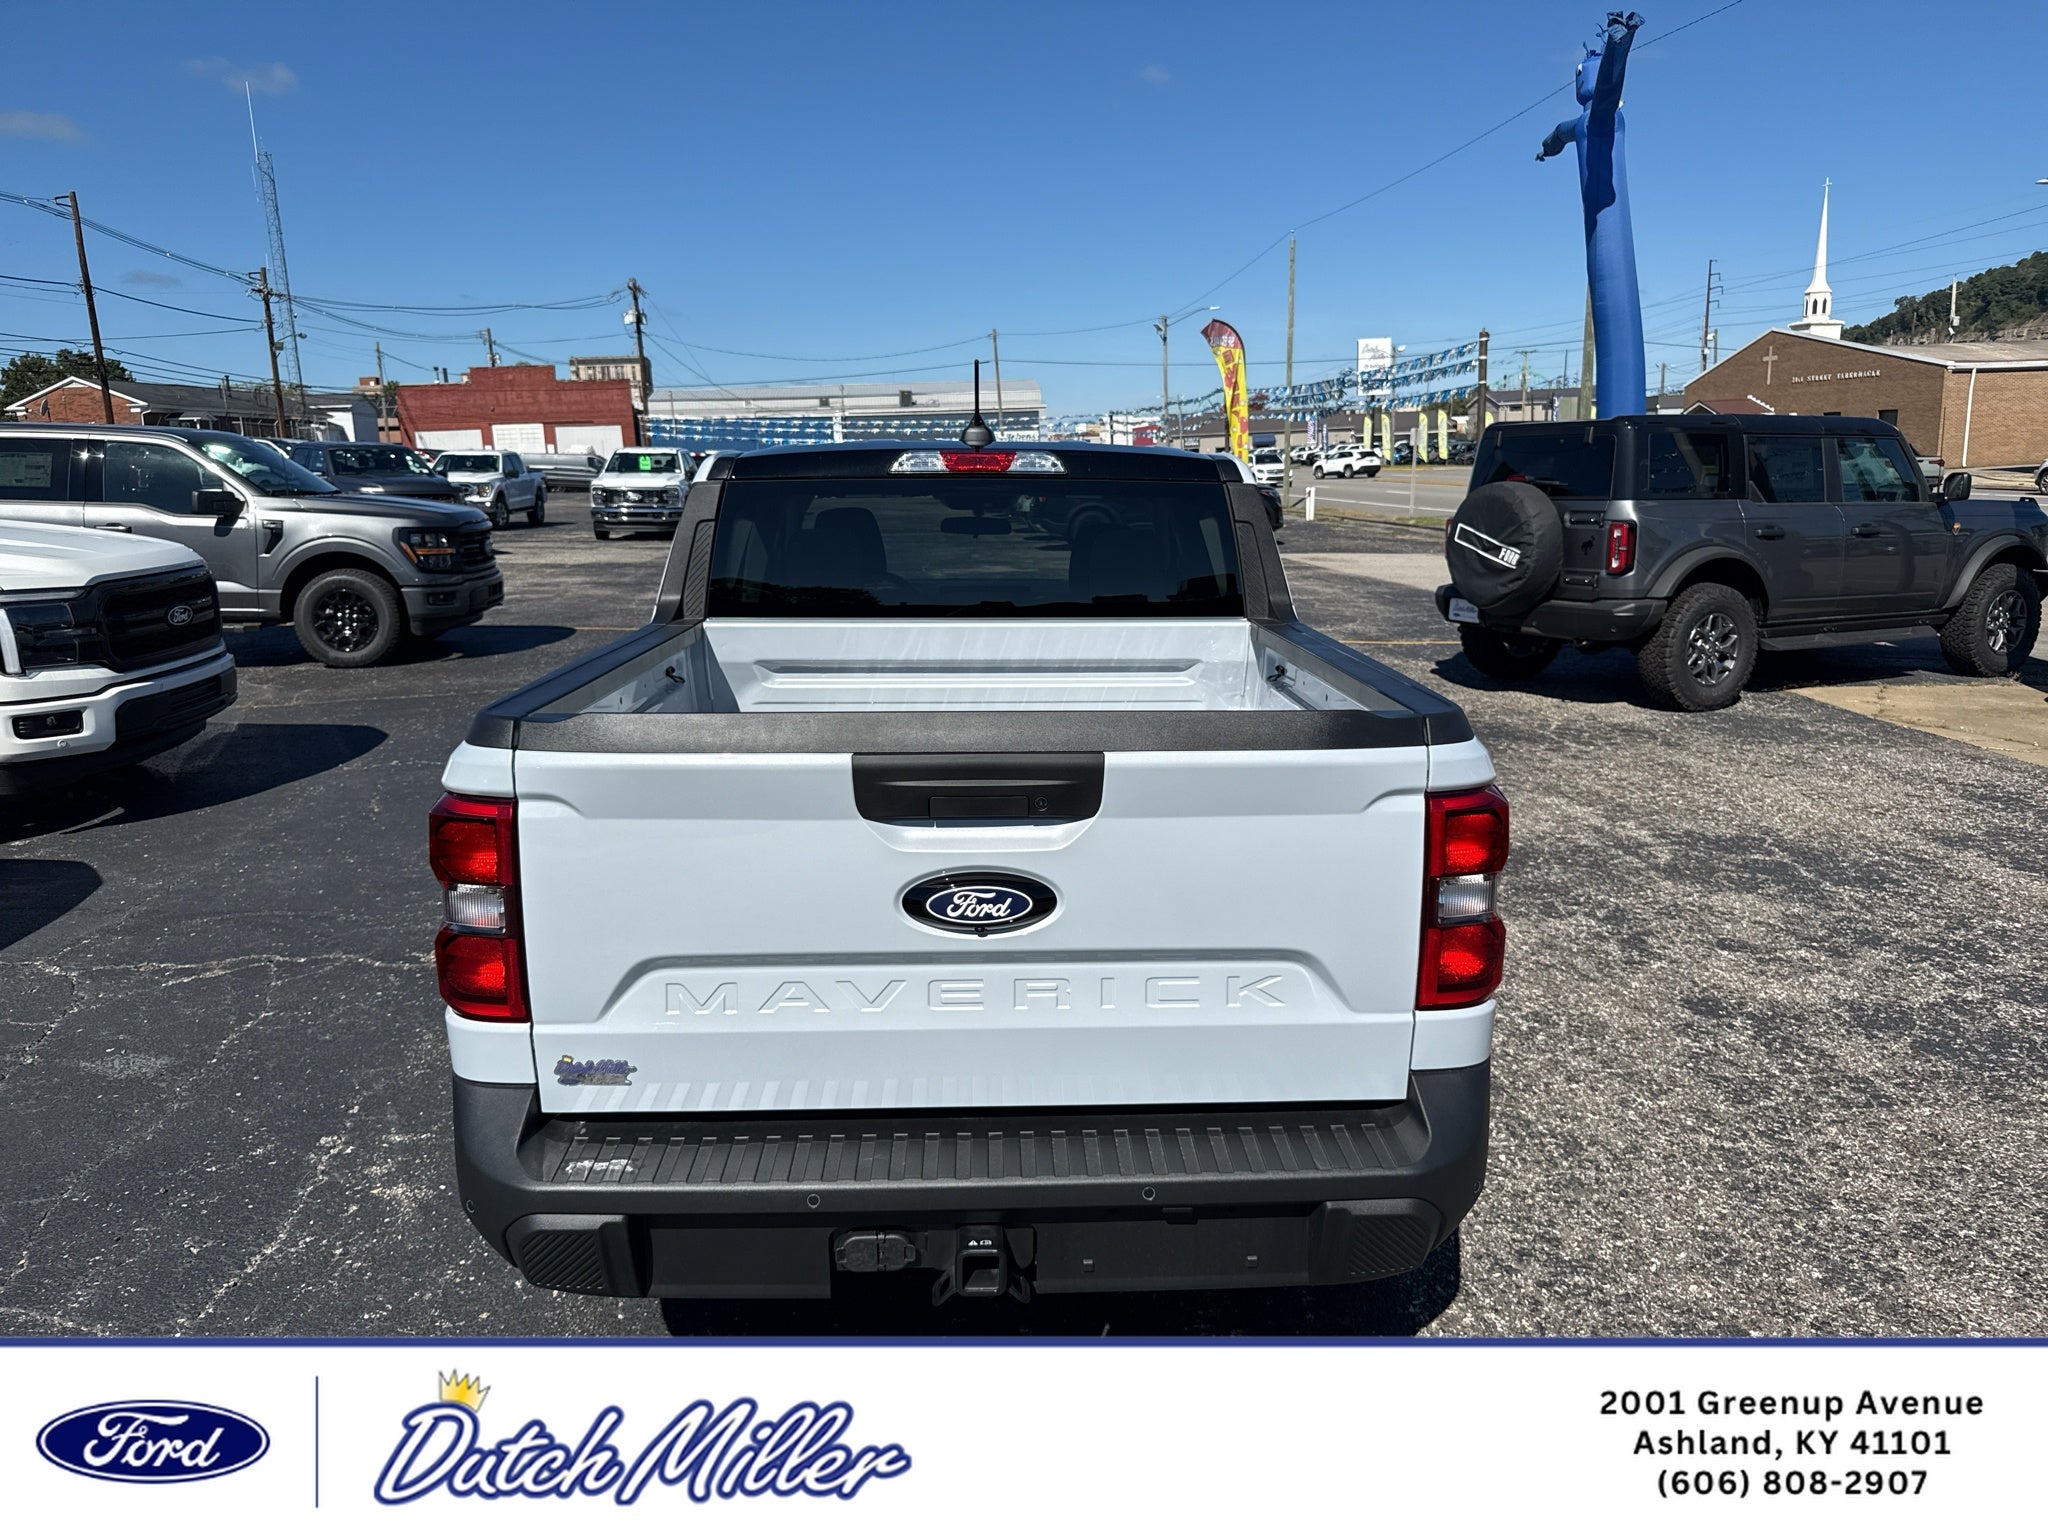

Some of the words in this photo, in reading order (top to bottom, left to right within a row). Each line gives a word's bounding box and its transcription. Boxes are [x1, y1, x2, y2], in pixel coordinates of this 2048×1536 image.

[1806, 373, 1832, 382] STREET
[1836, 369, 1881, 380] TABERNACLE
[946, 891, 1012, 918] Ford
[665, 975, 1286, 1015] MAVERICK
